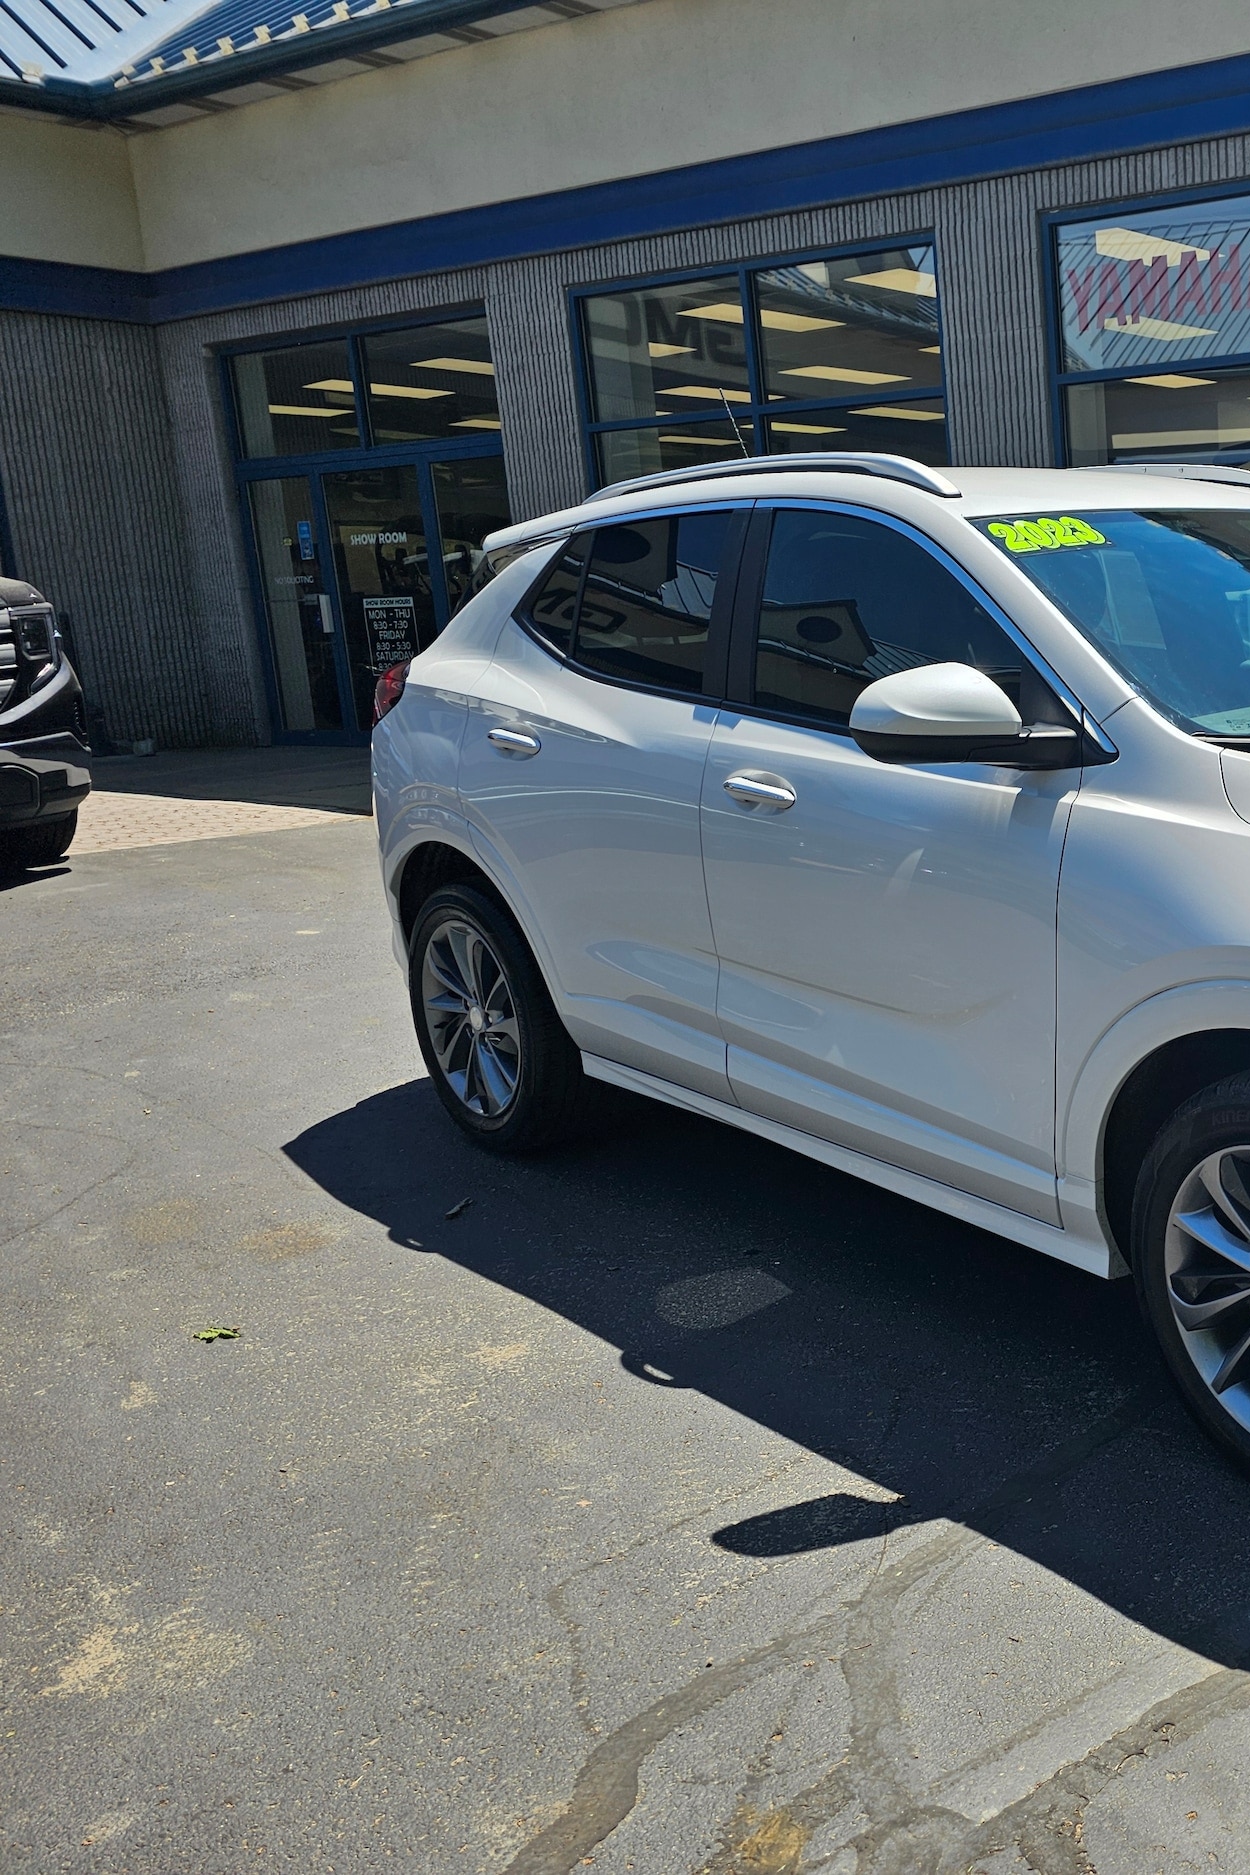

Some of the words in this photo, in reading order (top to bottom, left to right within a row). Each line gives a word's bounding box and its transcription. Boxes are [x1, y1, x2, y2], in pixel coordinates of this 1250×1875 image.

[350, 533, 377, 546] SHOW
[378, 531, 408, 544] ROOM
[988, 516, 1106, 553] 2023
[368, 609, 387, 620] MON
[394, 608, 411, 619] THU
[378, 629, 406, 640] FRIDAY
[376, 650, 415, 661] SATURDAY
